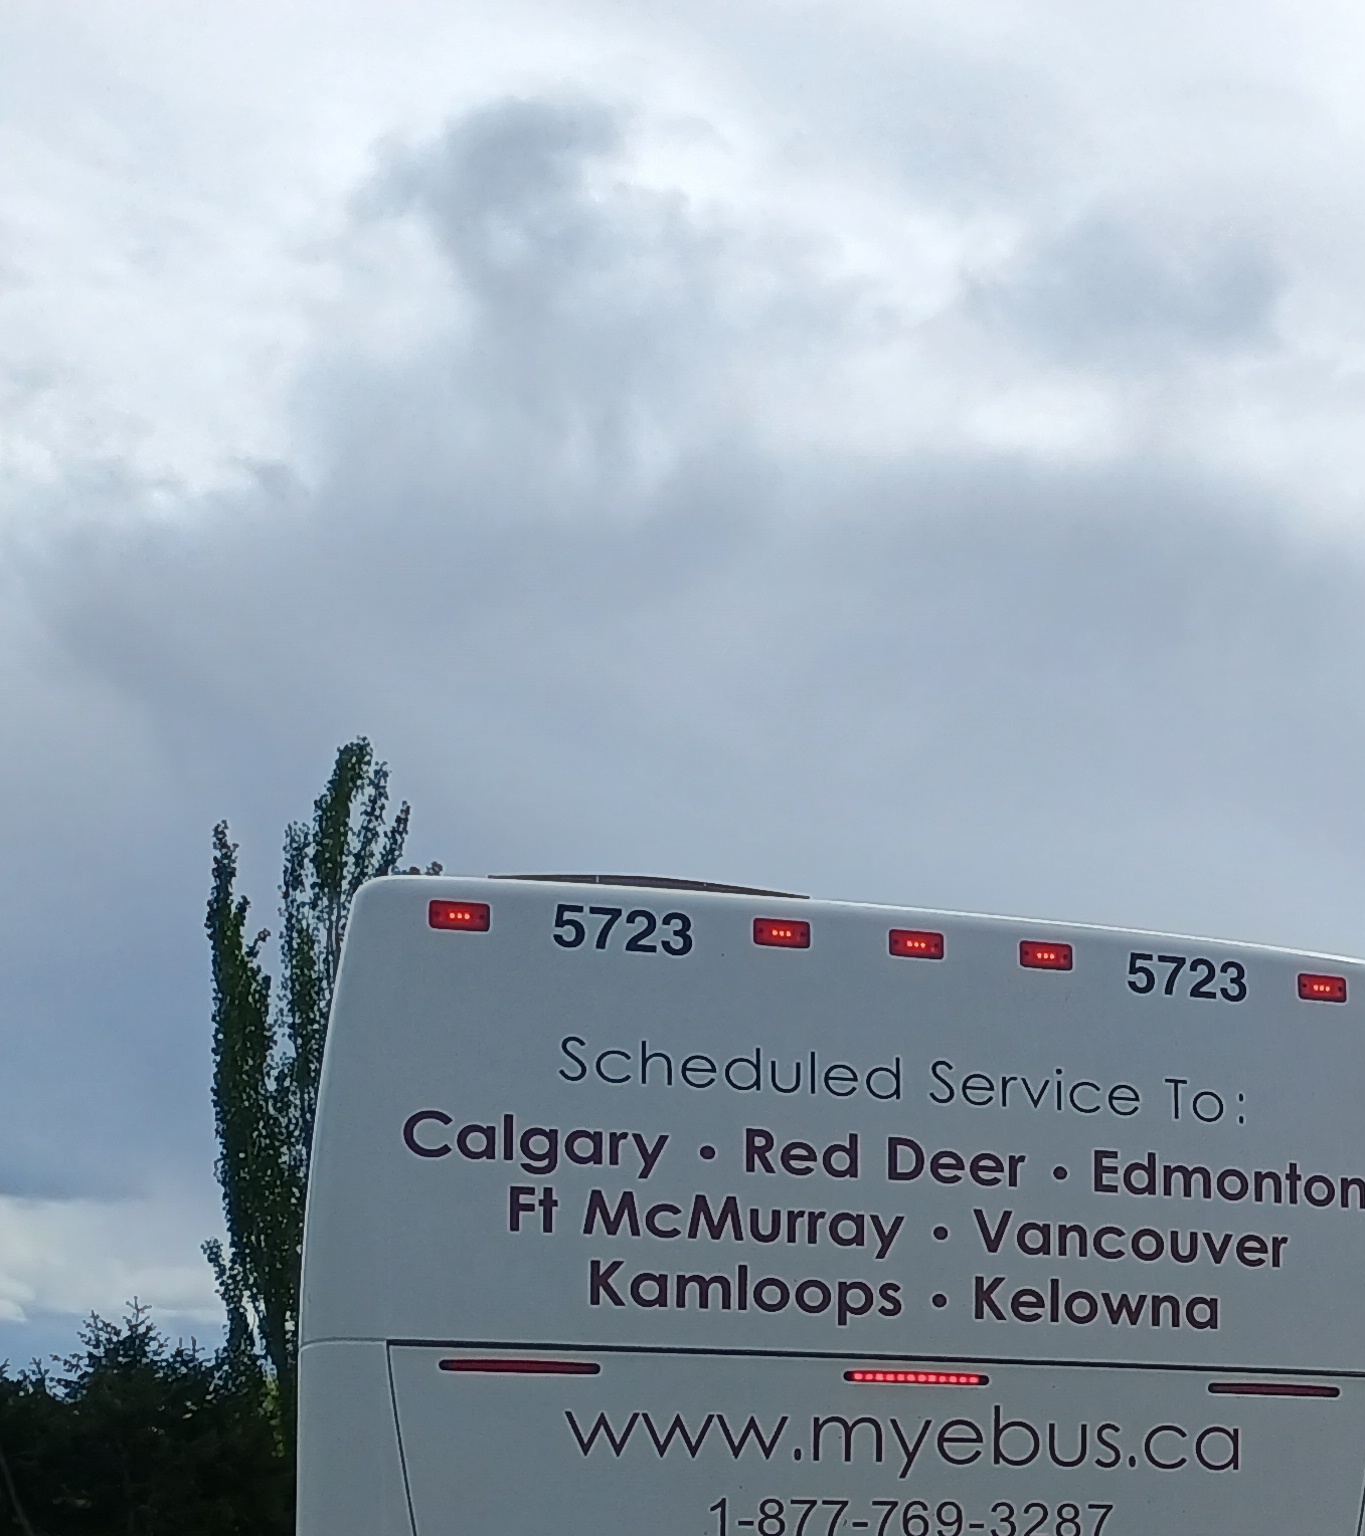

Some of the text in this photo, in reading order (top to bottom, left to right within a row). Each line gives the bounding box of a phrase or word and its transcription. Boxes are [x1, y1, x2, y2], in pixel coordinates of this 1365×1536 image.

[552, 903, 693, 956] 5723
[1127, 952, 1247, 1003] 5723
[558, 1036, 1244, 1124] Scheduled Service To:
[403, 1110, 670, 1179] Calgary
[745, 1127, 859, 1179] Red
[887, 1136, 1026, 1188] Deer
[509, 1185, 1289, 1268] Ft McMurray Vancouver
[590, 1259, 1218, 1330] Kamloops Kelowna
[564, 1404, 1239, 1479] www.myebus.ca
